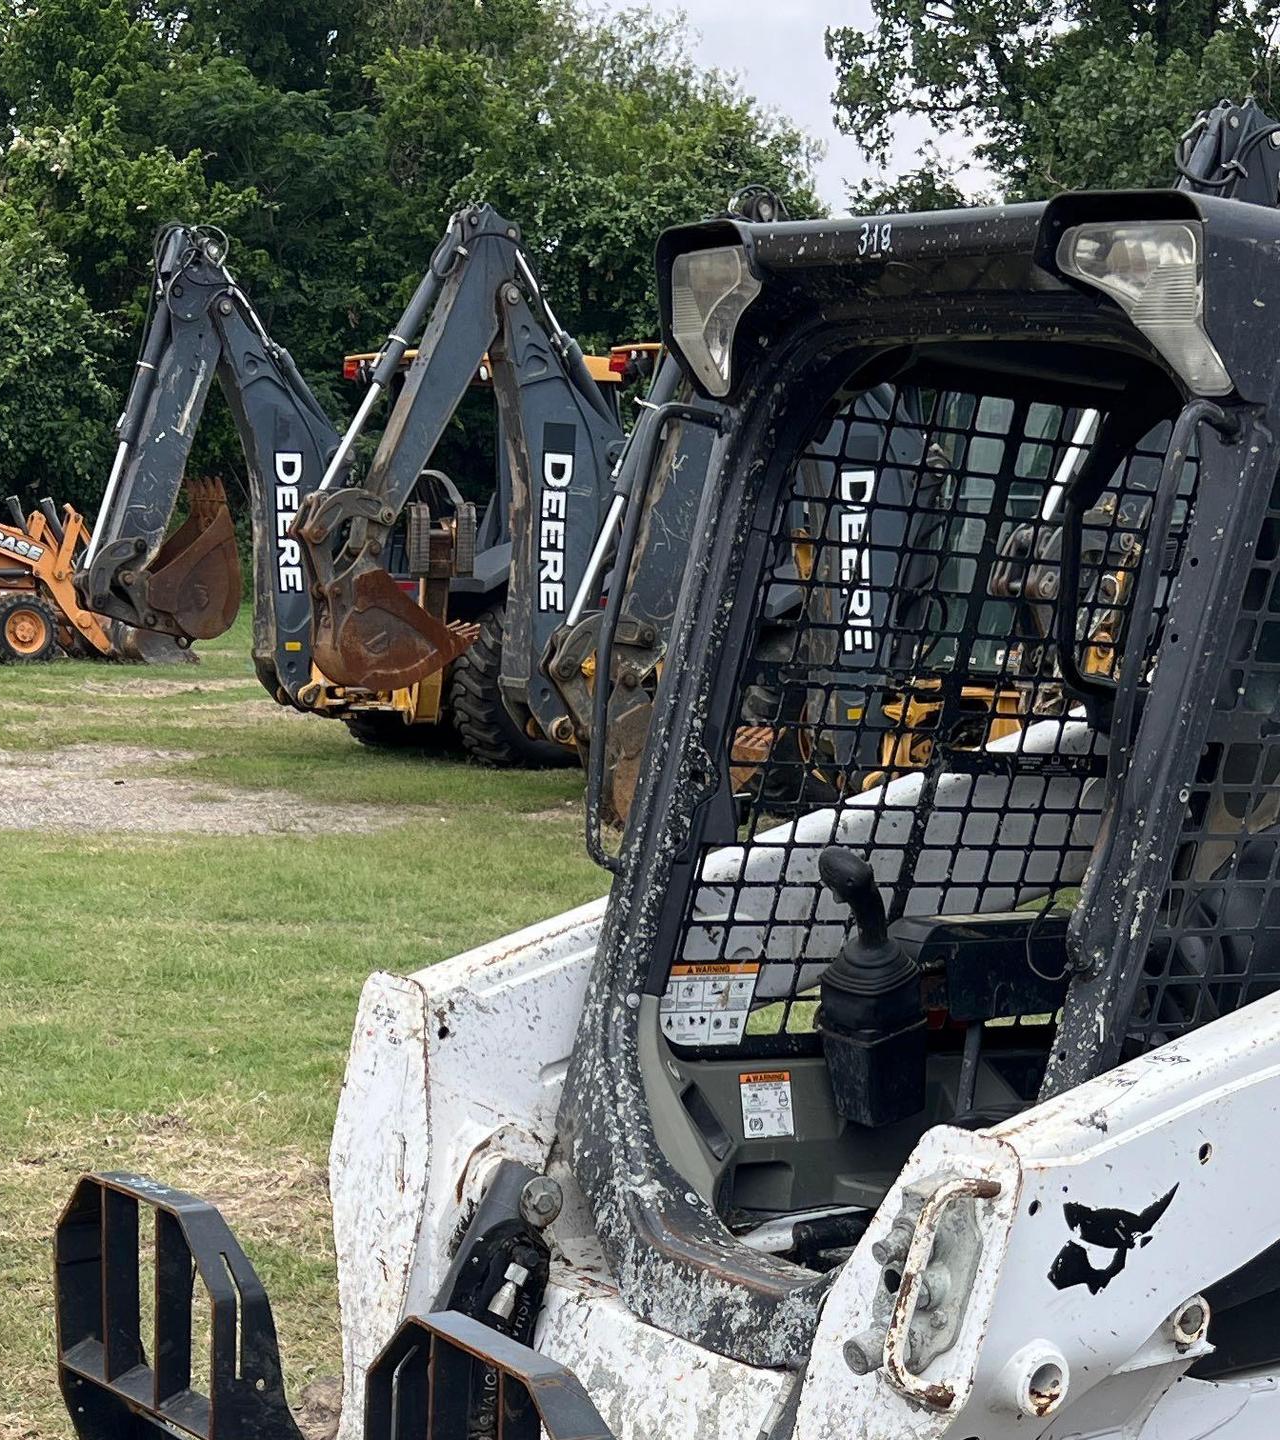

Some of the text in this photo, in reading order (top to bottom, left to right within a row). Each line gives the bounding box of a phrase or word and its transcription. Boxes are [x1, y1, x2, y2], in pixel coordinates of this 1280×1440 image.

[274, 451, 304, 594] DEERE
[540, 451, 574, 612] DEERE
[840, 469, 875, 653] DEERE
[695, 965, 731, 973] WARNING
[752, 1072, 785, 1082] WARNING
